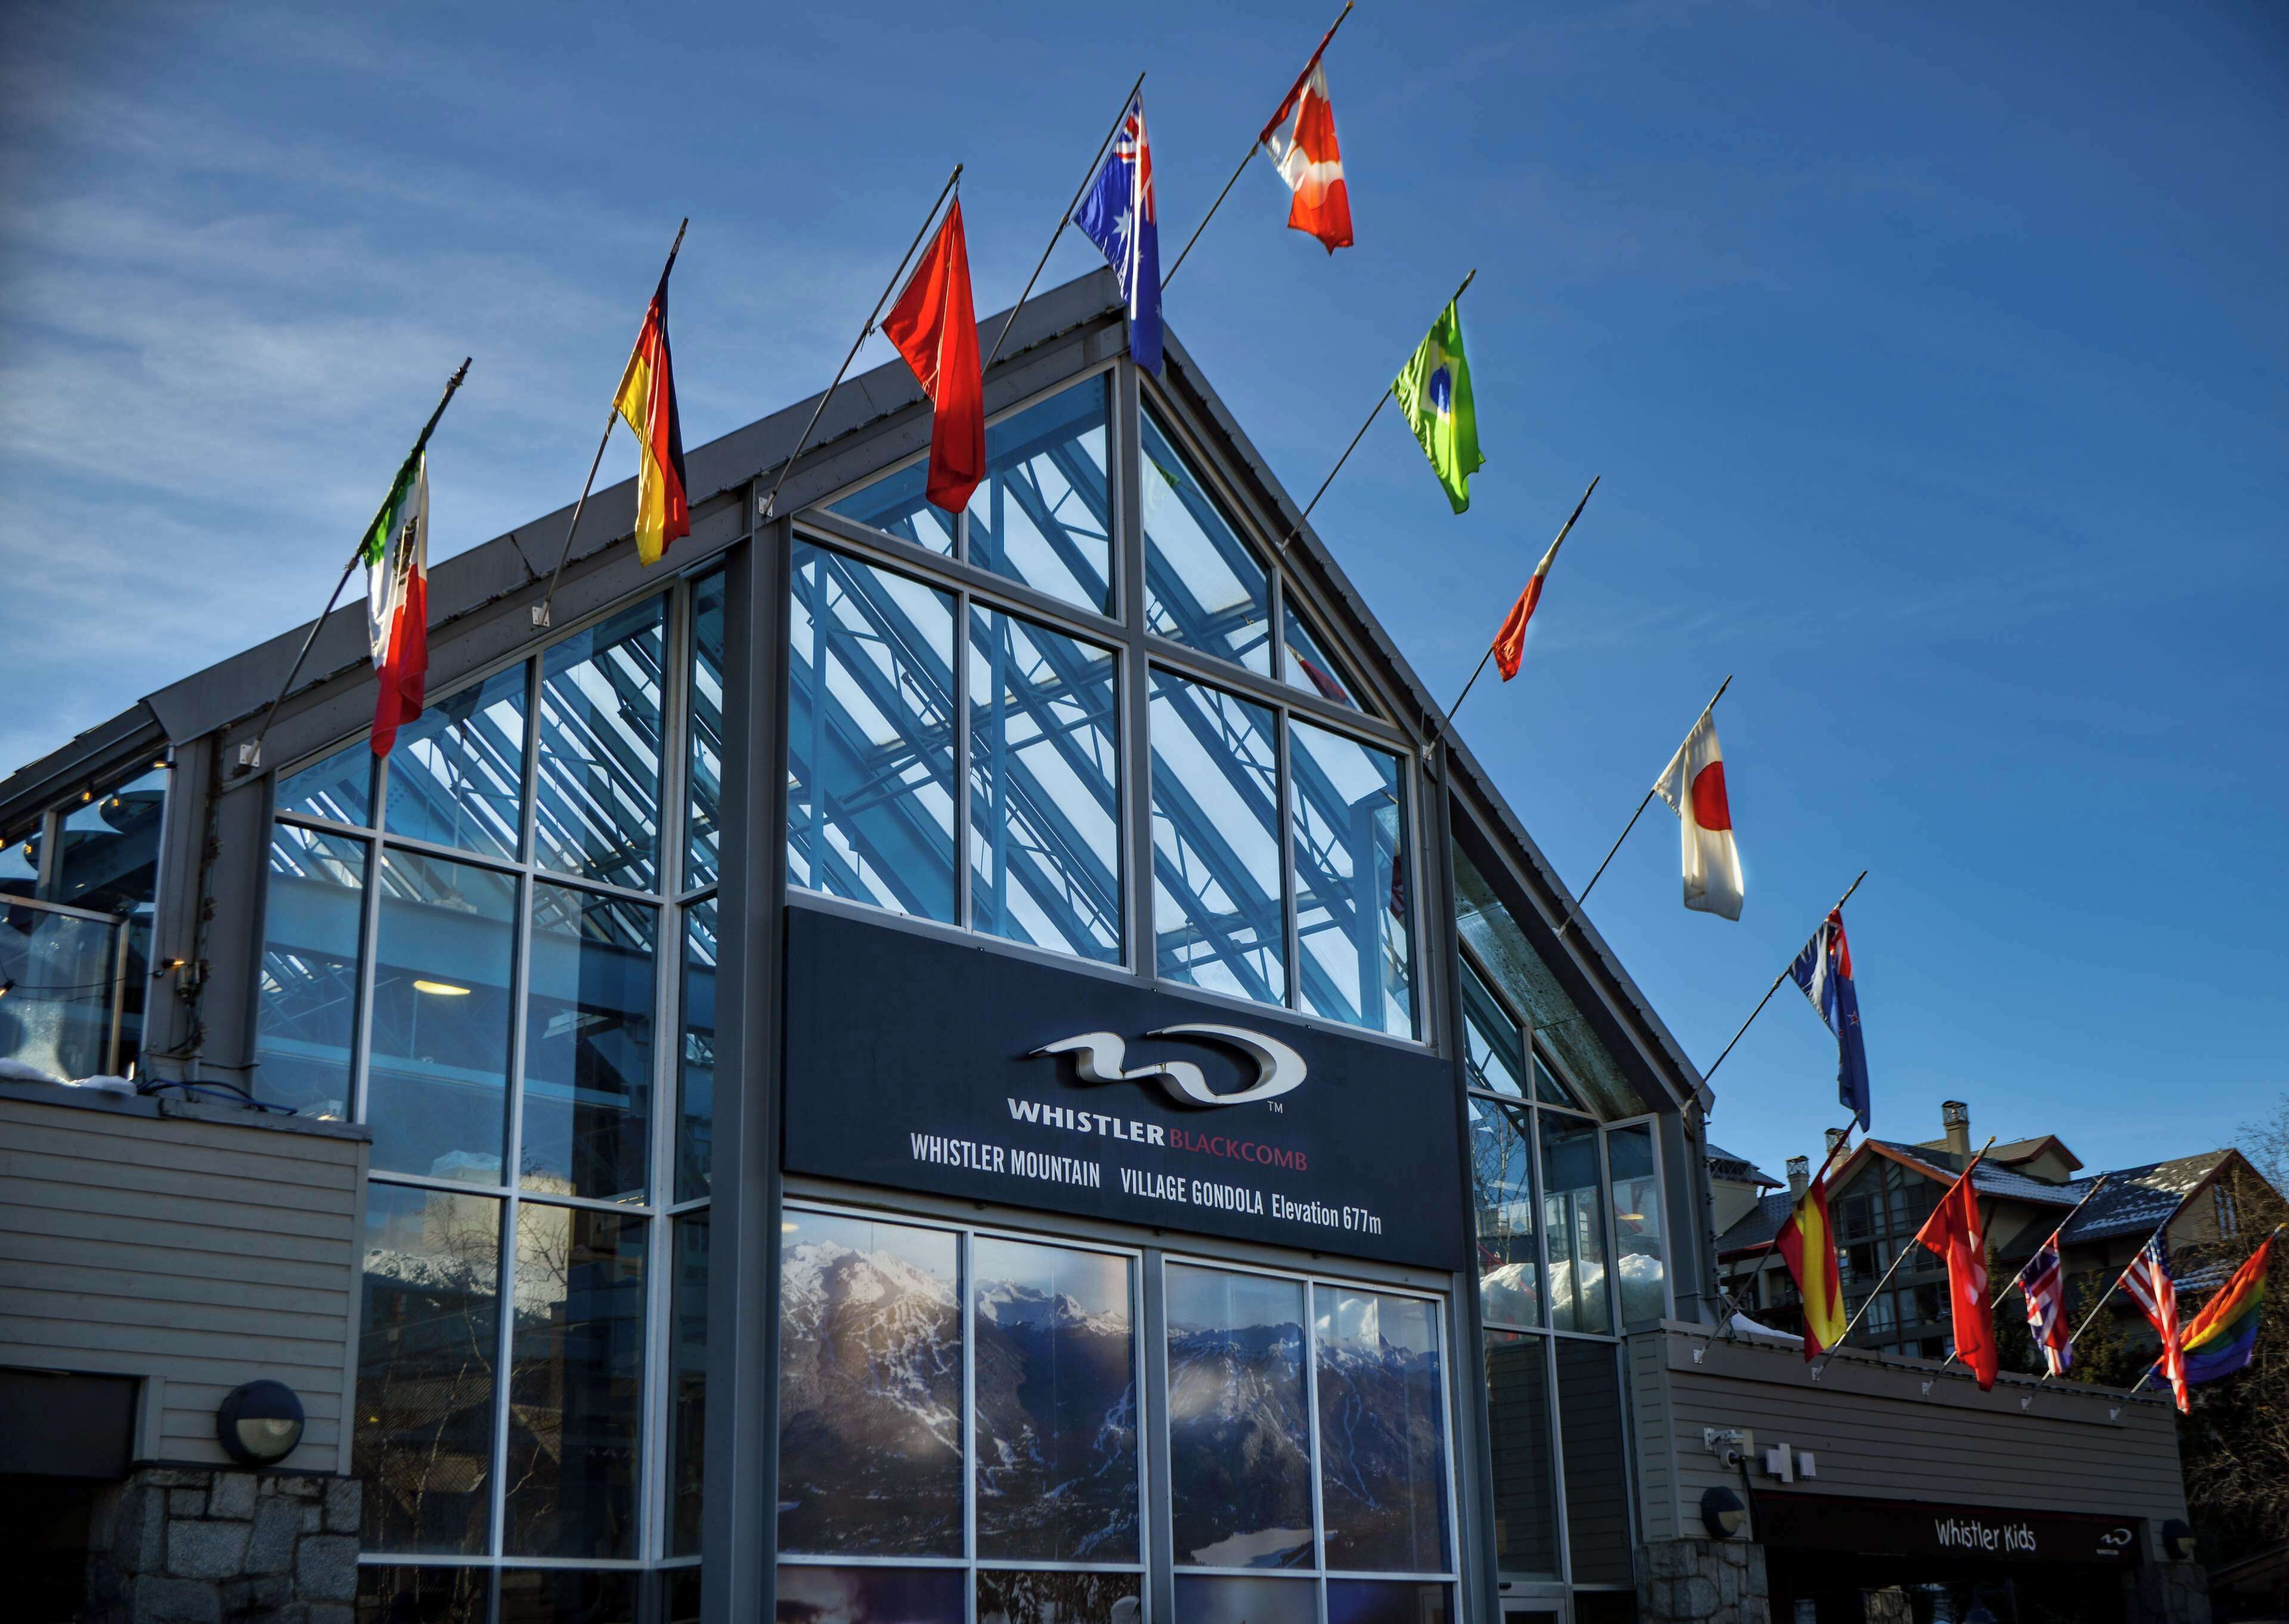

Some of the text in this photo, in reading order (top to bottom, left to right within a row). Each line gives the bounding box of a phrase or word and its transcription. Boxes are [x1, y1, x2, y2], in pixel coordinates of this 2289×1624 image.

[1007, 1098, 1308, 1171] WHISTLER BLACKCOMB
[910, 1132, 1382, 1235] WHISTLER MOUNTAIN VILLAGE GONDOLA Elevation 677m
[1935, 1518, 2036, 1552] Whistler Kids
